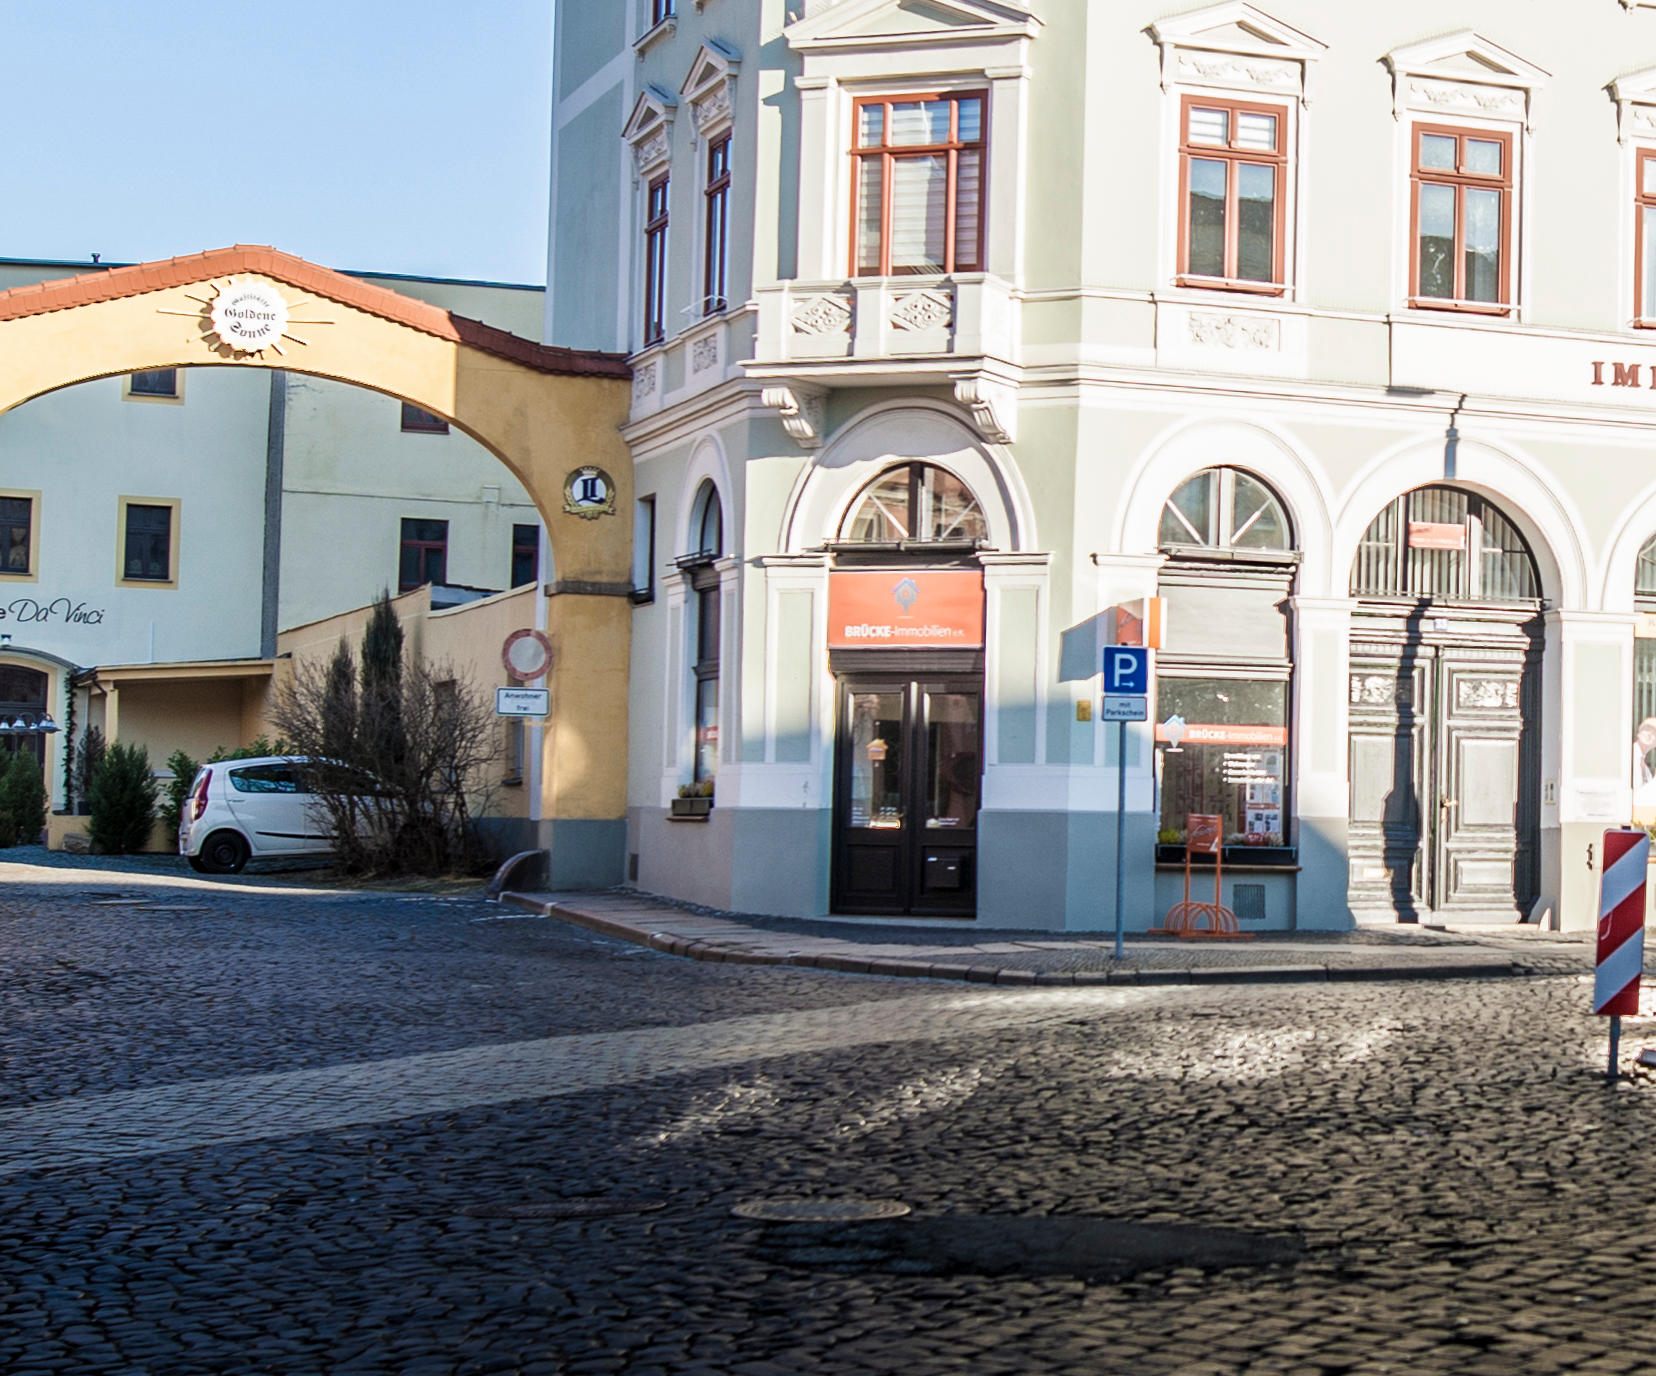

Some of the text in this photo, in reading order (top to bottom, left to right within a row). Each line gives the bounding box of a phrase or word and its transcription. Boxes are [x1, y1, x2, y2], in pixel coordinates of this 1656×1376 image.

[224, 308, 276, 321] Goldene
[230, 321, 271, 338] Sonne
[8, 598, 49, 622] Da
[49, 597, 105, 624] Vinci
[844, 624, 951, 638] BRÜCKE-Immobilien
[1114, 653, 1138, 688] P
[1106, 708, 1144, 716] Parkschein
